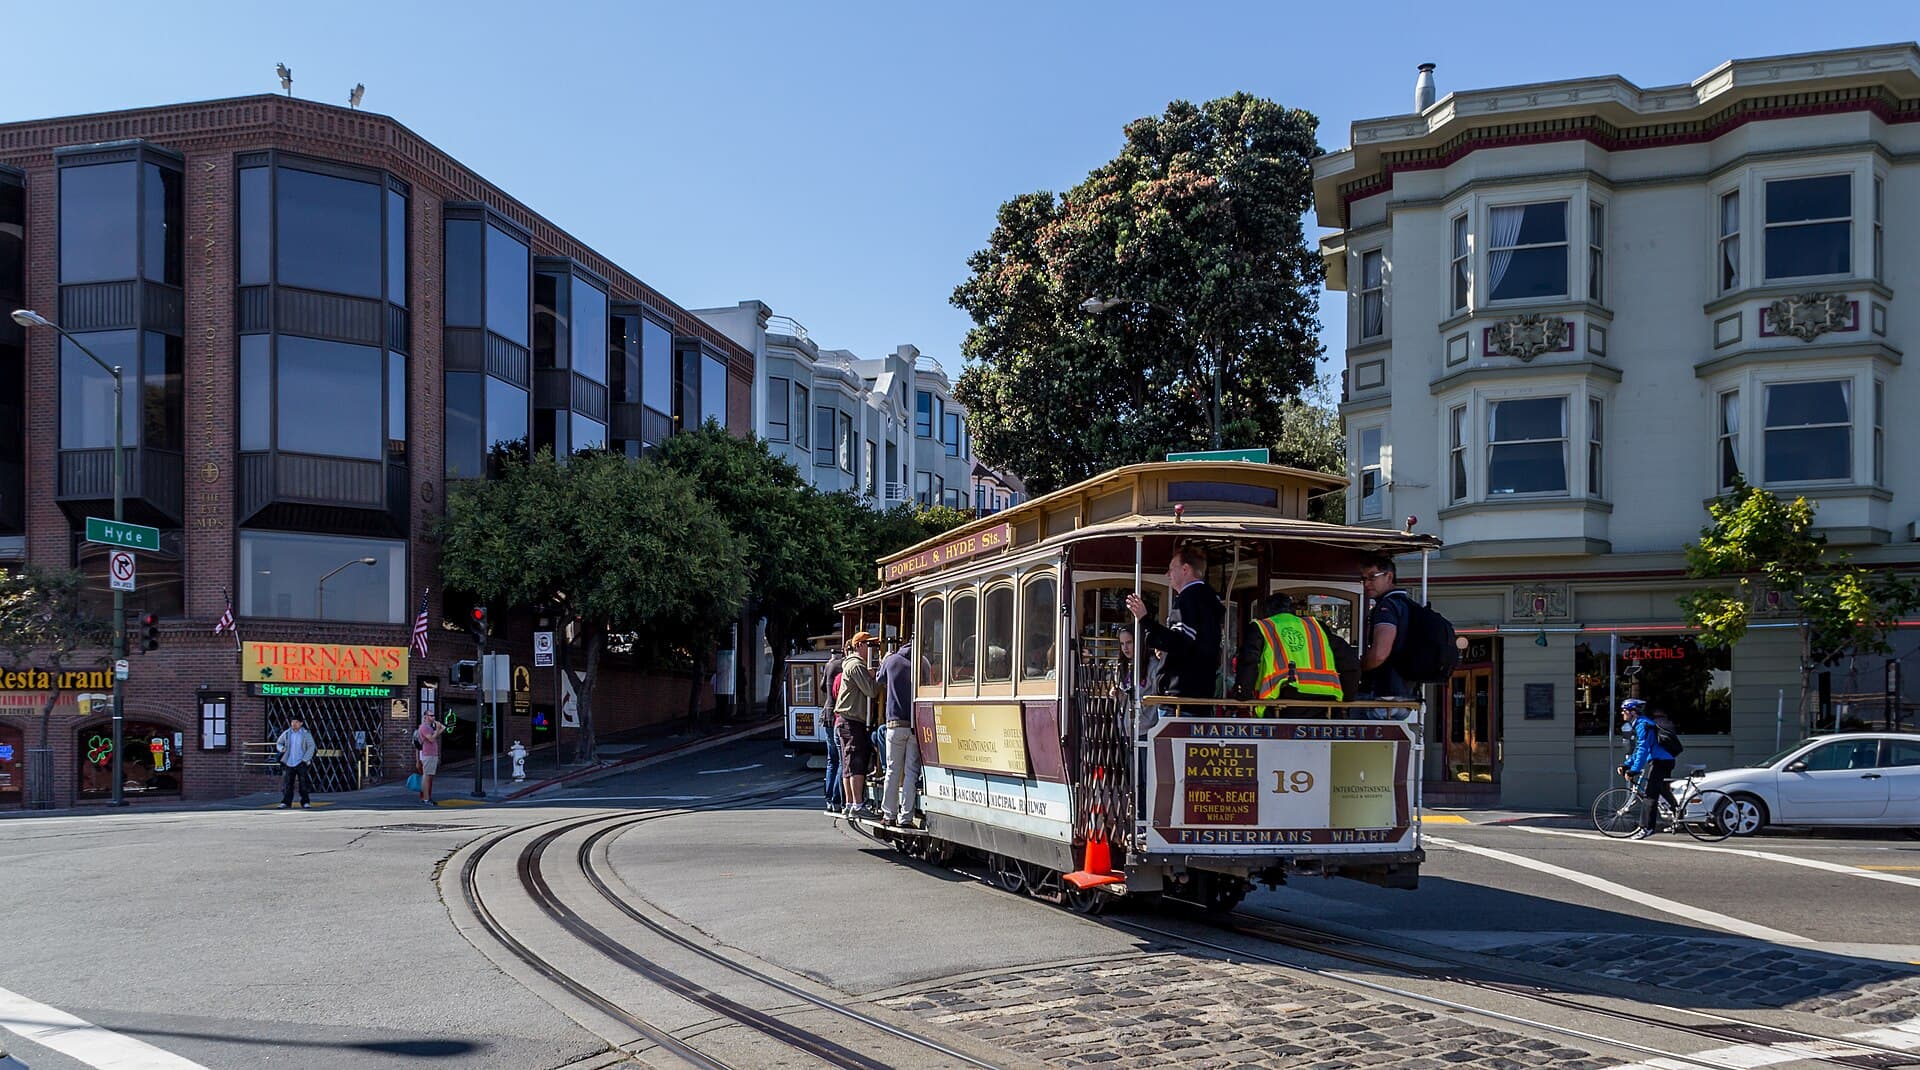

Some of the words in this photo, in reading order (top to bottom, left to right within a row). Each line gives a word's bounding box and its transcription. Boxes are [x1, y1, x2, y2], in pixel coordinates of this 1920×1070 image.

[104, 525, 142, 542] Hyde
[891, 557, 928, 577] POWELL
[932, 550, 940, 563] &
[946, 538, 976, 560] HYDE
[981, 532, 1001, 547] Sts.
[253, 644, 400, 670] TIERNAN'S
[1623, 648, 1685, 660] COCKTAILS
[283, 665, 332, 682] IRISH
[336, 668, 372, 682] PUB
[262, 684, 300, 697] Singer
[303, 685, 325, 695] and
[328, 685, 391, 698] Songwriter
[922, 726, 933, 743] 19
[1192, 724, 1277, 737] MARKET
[1296, 726, 1368, 738] STREET
[1189, 747, 1255, 759] POWELL
[1206, 759, 1238, 767] AND
[1187, 766, 1255, 777] MARKET
[1272, 770, 1314, 793] 19
[939, 785, 950, 796] SAN
[951, 787, 983, 803] FANCISCO
[983, 792, 1017, 810] NICIPAL
[1019, 799, 1048, 816] RILWAY
[1188, 791, 1212, 803] HYDE
[1225, 791, 1255, 803] BEACH
[1193, 804, 1249, 814] FISHERMANS
[1181, 830, 1313, 842] FISHERMANS
[1332, 830, 1389, 842] WHARF
